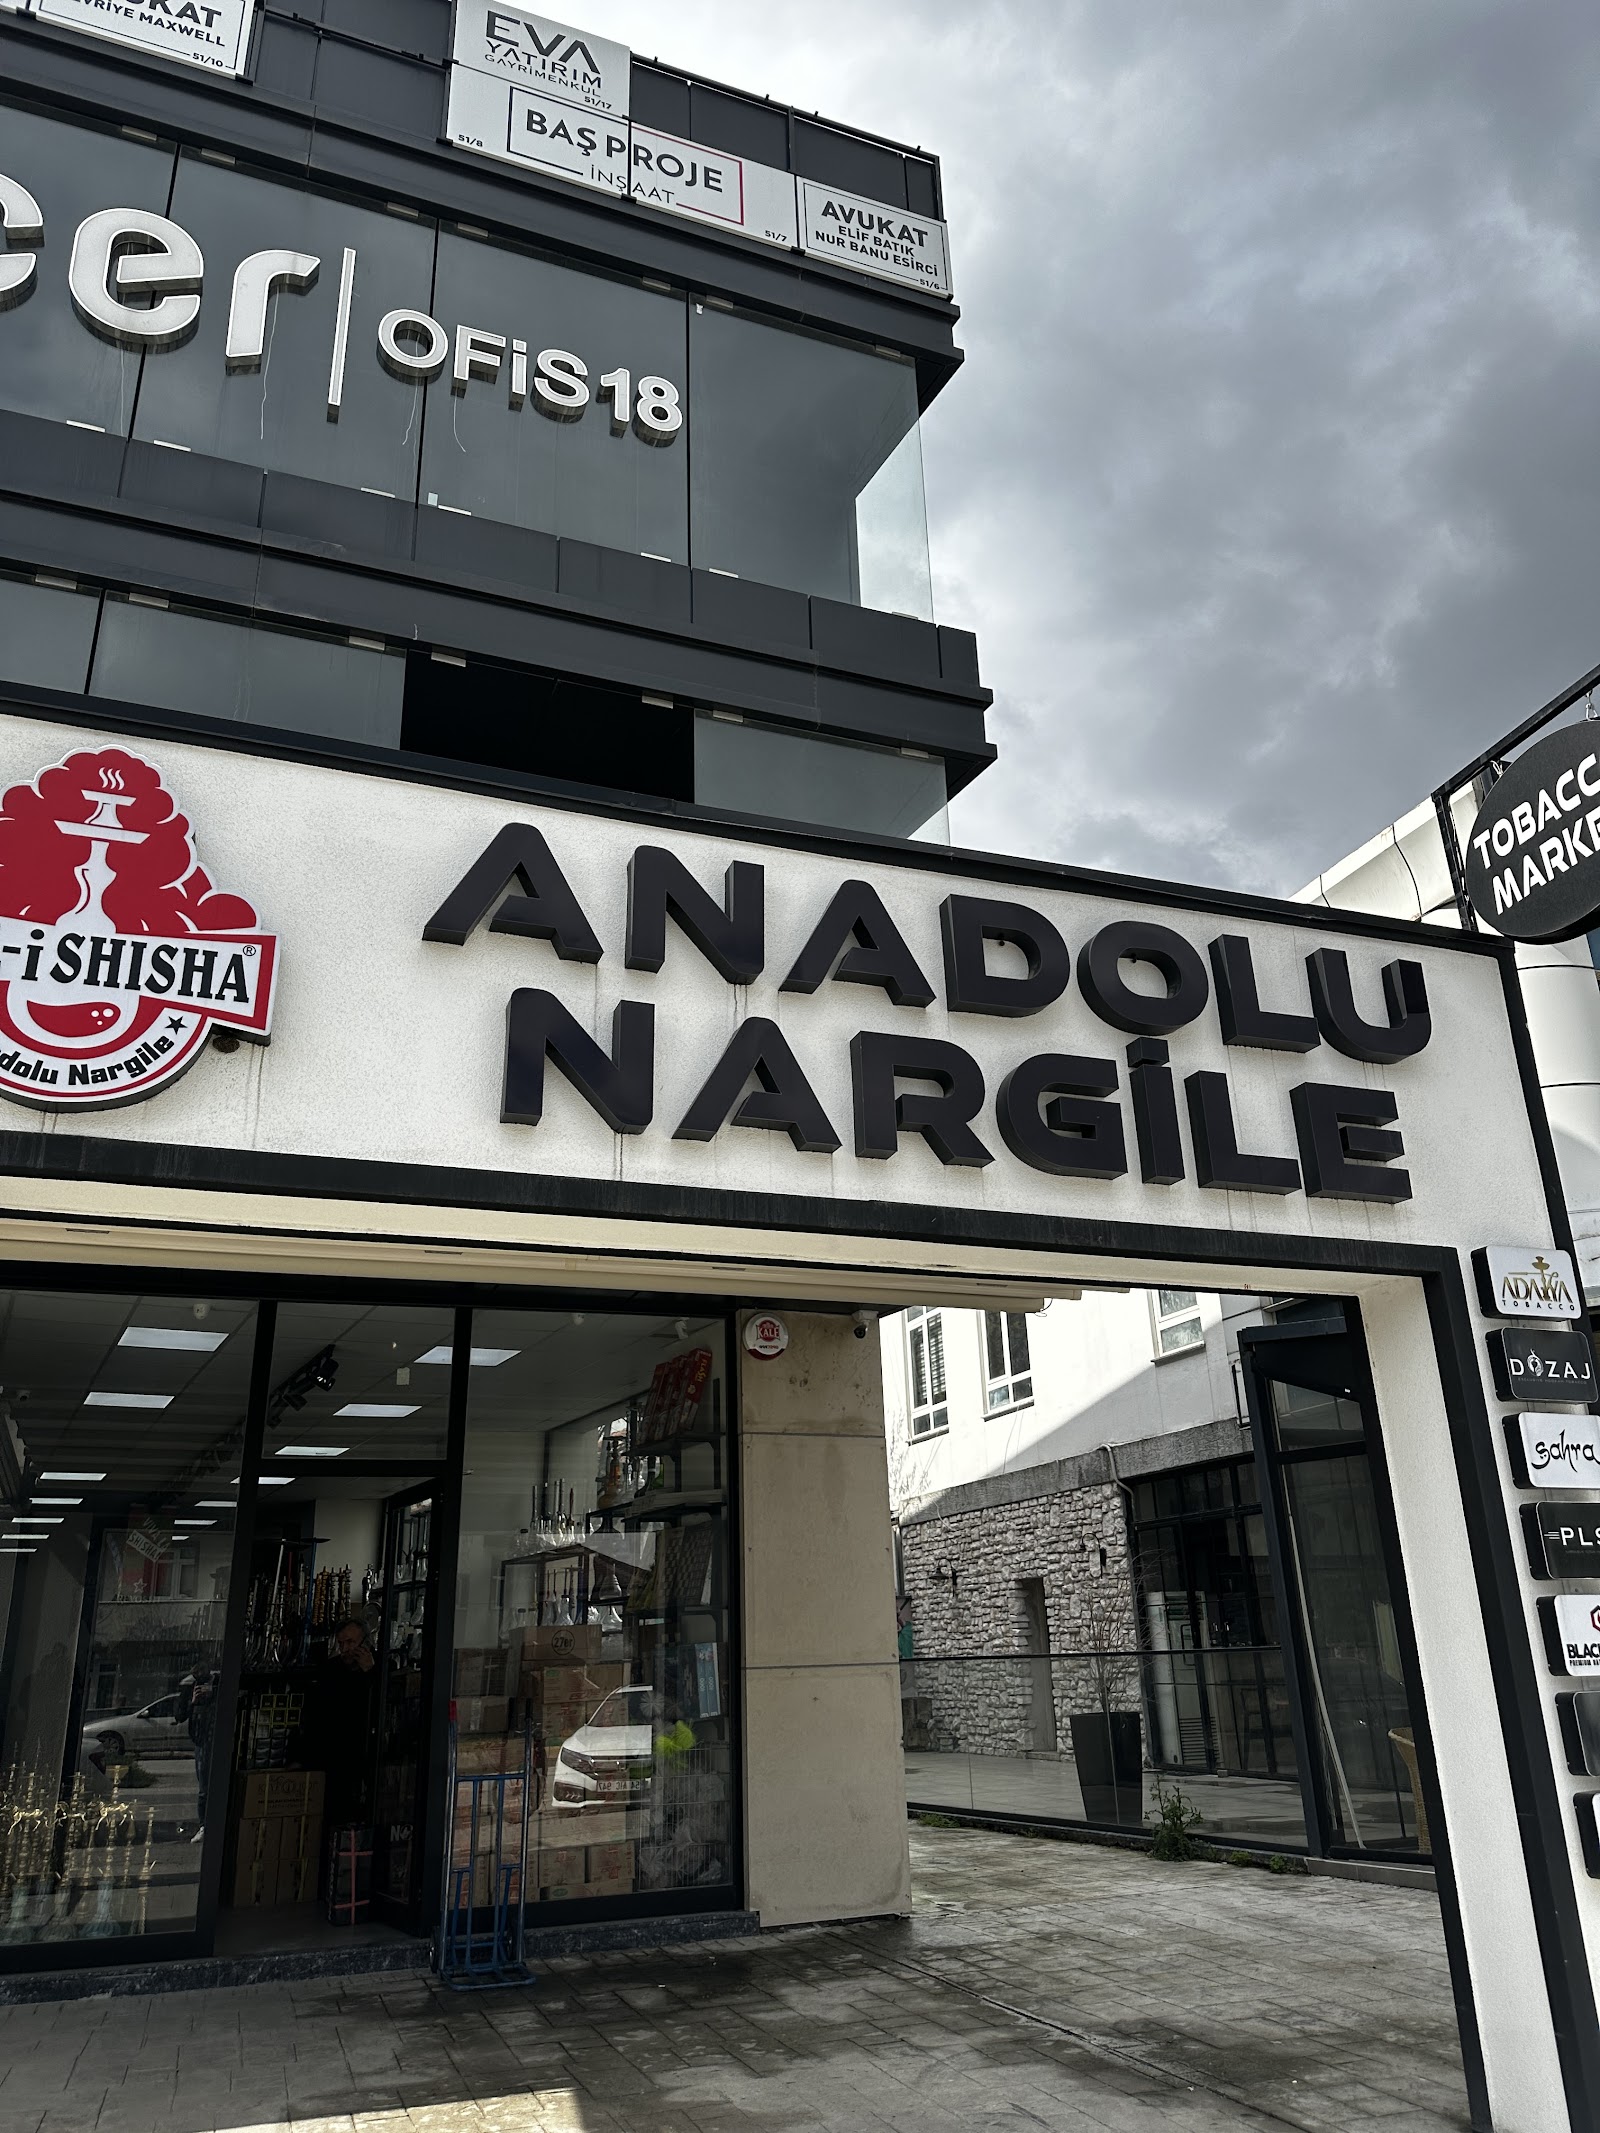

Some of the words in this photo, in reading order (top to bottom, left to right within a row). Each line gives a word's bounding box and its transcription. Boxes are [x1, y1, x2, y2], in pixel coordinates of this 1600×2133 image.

[125, 0, 221, 28] KAT
[139, 12, 225, 47] MAXWELL
[192, 52, 223, 68] 51/10
[486, 10, 601, 74] EVA
[486, 40, 602, 89] YATIRIM
[484, 53, 602, 98] GAYRİMENKUL
[584, 96, 612, 110] 51/17
[458, 134, 483, 148] 51/8
[526, 109, 597, 156] BAŞ
[606, 134, 723, 193] PROJE
[590, 164, 675, 205] İNŞAAT
[764, 230, 788, 242] 51/7
[821, 200, 928, 247] AVUKAT
[838, 226, 870, 241] ELİF
[873, 237, 914, 257] BATIK
[815, 231, 846, 249] NUR
[850, 243, 889, 261] BANU
[893, 254, 938, 277] ESİRCİ
[920, 279, 940, 291] 51/6
[598, 367, 684, 447] 18
[421, 822, 1433, 1064] ANADOLU
[50, 932, 250, 1004] SHISHA
[0, 1050, 58, 1084] dolu
[68, 1034, 174, 1087] Nargile
[499, 986, 1413, 1203] NARGİLE
[1502, 1299, 1576, 1311] TOBACCO
